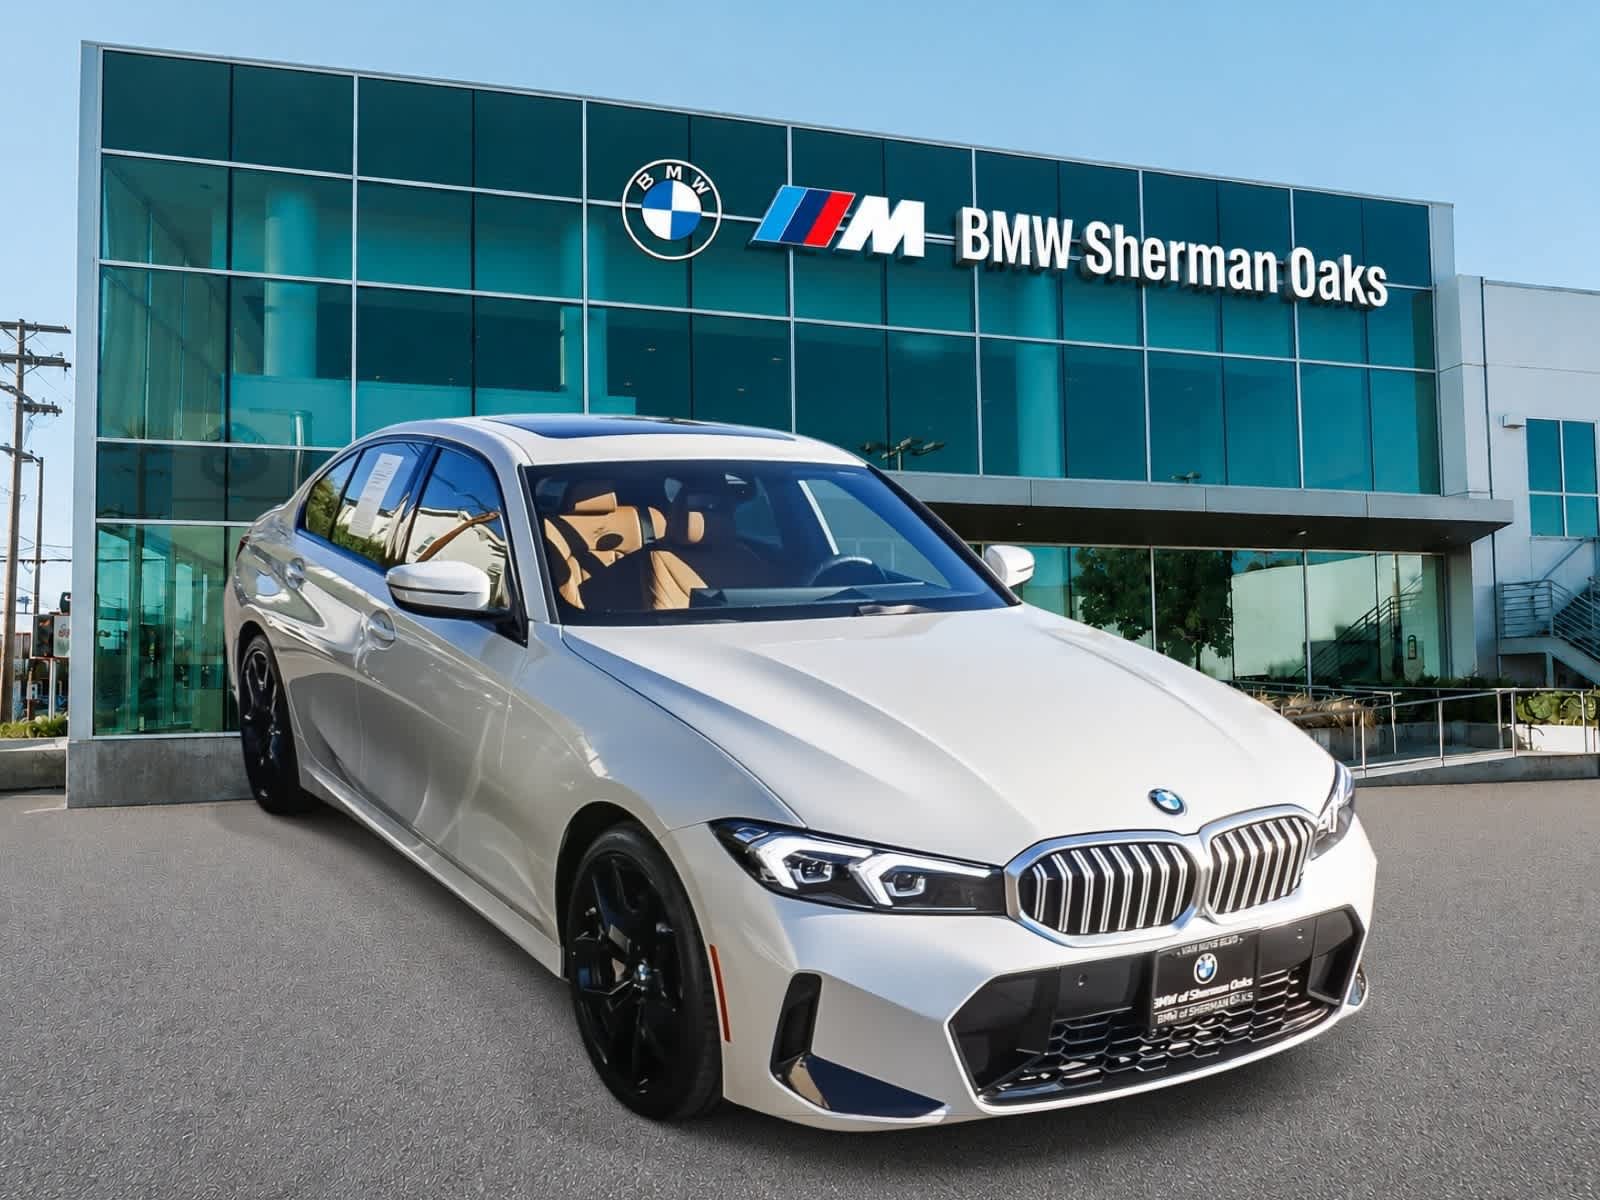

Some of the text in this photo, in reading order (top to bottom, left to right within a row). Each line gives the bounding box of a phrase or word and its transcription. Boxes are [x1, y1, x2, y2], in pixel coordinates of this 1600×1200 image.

[636, 164, 712, 196] BMW
[836, 195, 925, 257] M
[961, 206, 1388, 308] BMW Sherman Oaks
[1178, 990, 1189, 1003] of
[1188, 984, 1230, 1001] Sherman
[1230, 977, 1253, 990] Oaks
[1179, 1007, 1188, 1018] of
[1188, 997, 1229, 1017] SHERMAN
